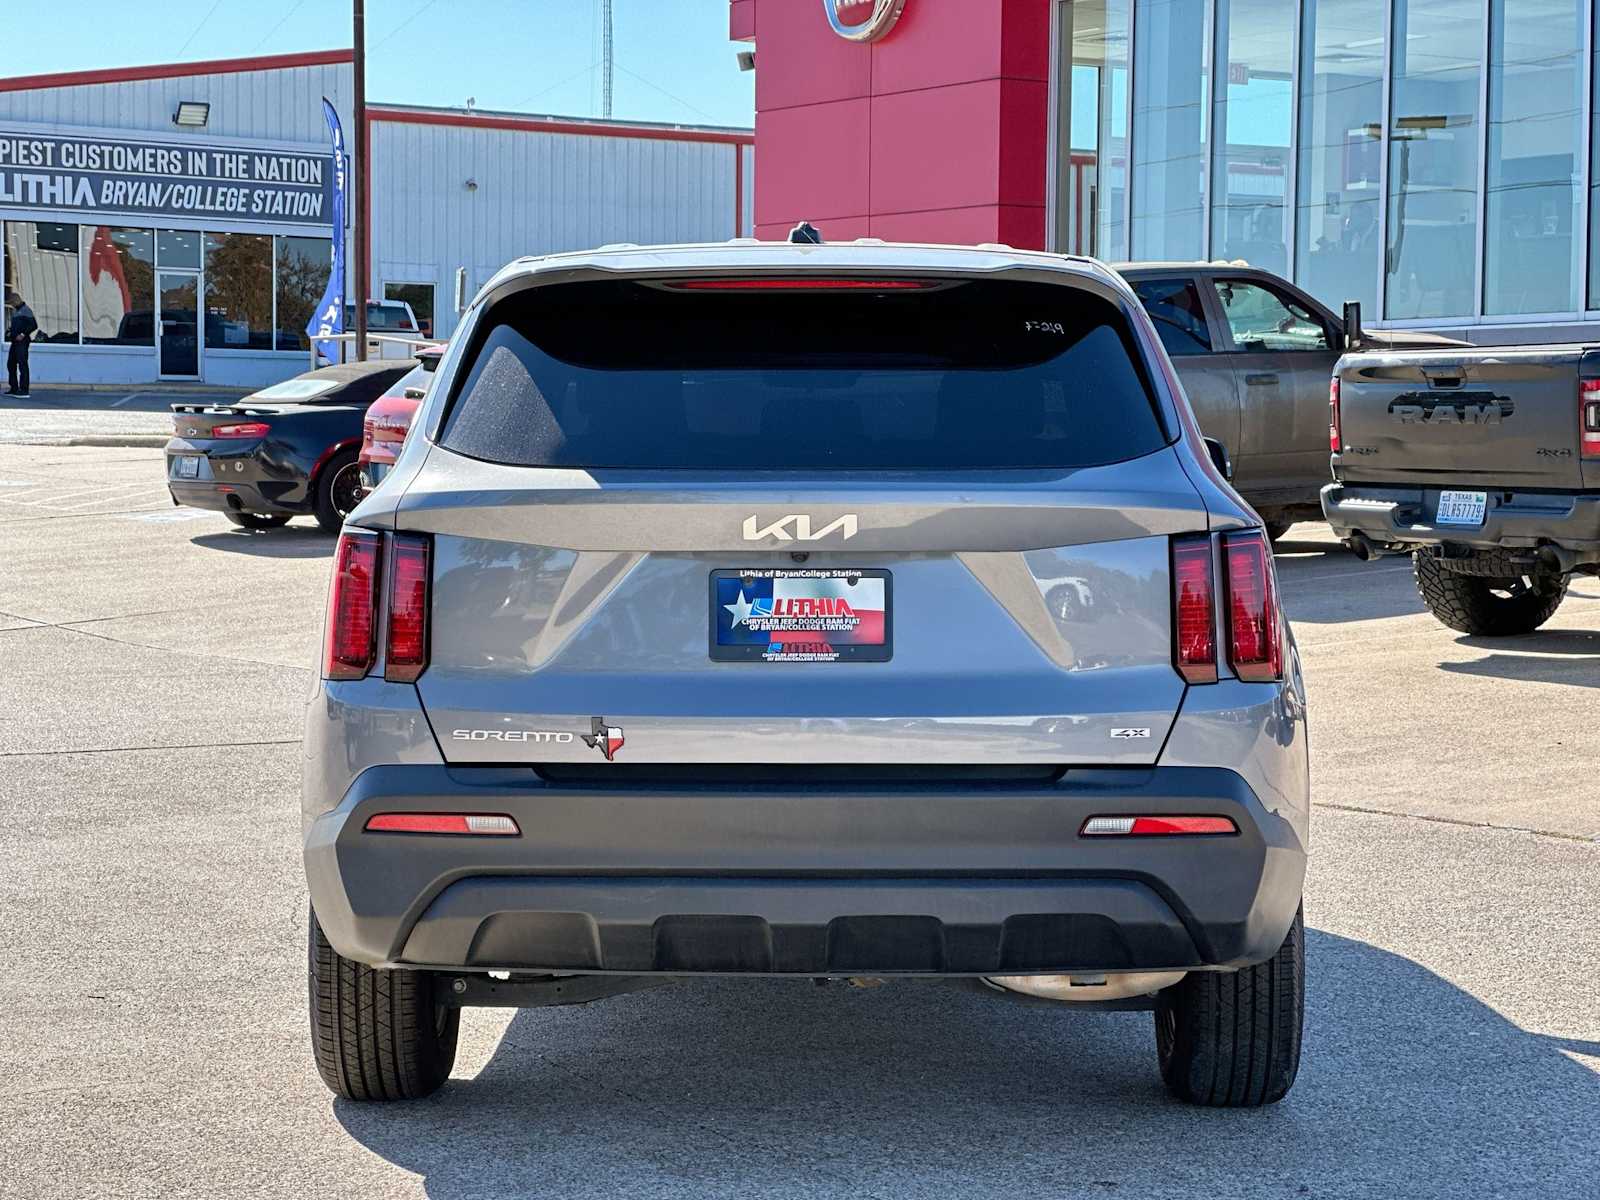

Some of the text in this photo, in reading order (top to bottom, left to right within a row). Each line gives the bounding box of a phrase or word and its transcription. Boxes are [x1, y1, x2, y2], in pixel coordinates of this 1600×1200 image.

[61, 143, 182, 174] CUSTOMERS
[188, 151, 207, 176] IN
[212, 153, 249, 178] THE
[254, 156, 322, 183] NATION
[0, 172, 323, 217] LITHIA BRYAN/COLLEGE STATION
[1391, 405, 1504, 425] RAM
[743, 514, 858, 541] KIA
[739, 570, 862, 579] Lithia of Bryan/College Station
[773, 598, 856, 617] LITHIA
[452, 729, 574, 743] SORENTO
